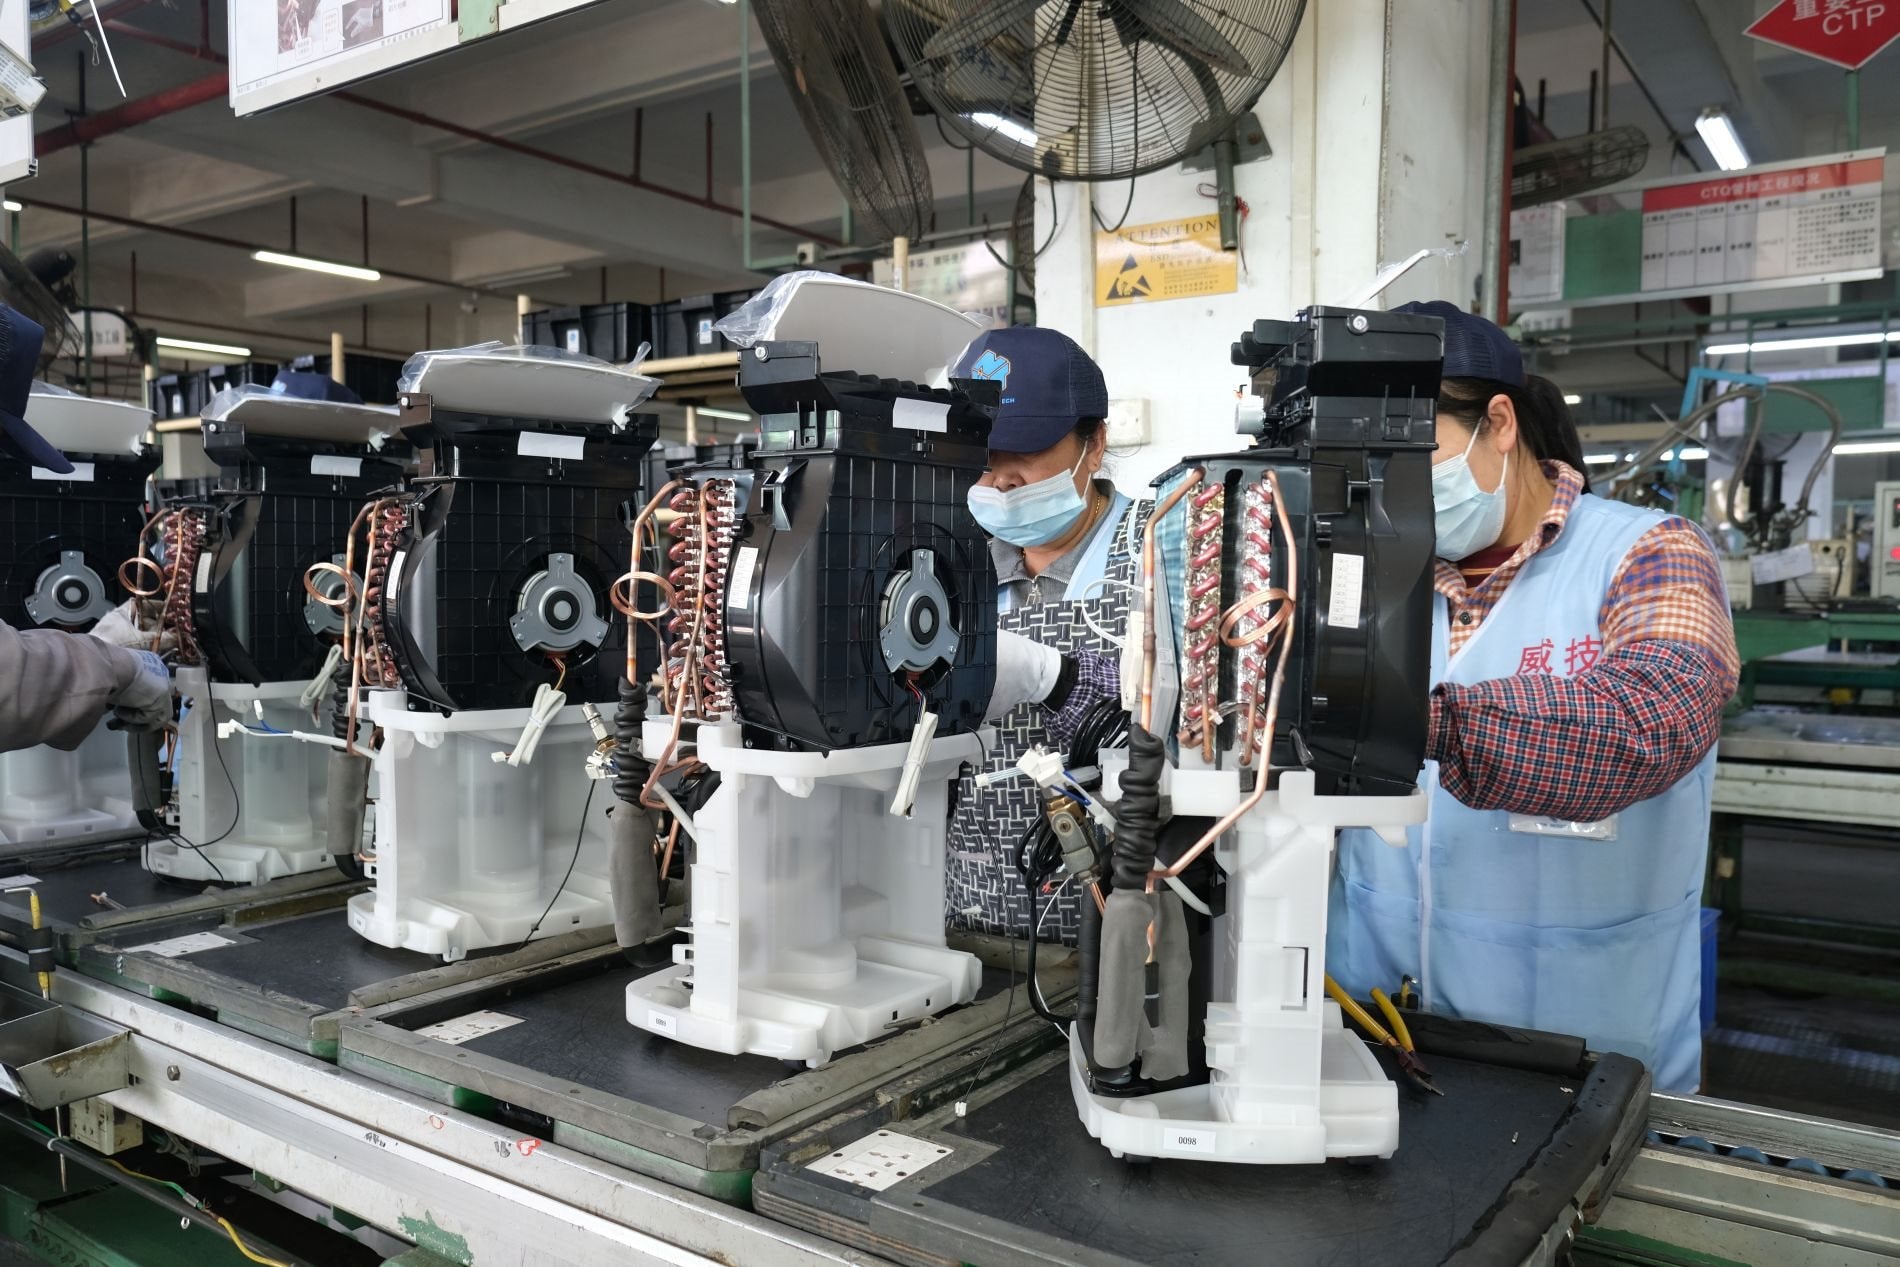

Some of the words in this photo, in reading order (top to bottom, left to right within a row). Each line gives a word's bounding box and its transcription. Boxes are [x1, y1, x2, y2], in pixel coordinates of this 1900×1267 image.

[1822, 4, 1886, 36] CTP
[1115, 218, 1218, 244] ATTENTION
[1178, 1136, 1197, 1145] 0098
